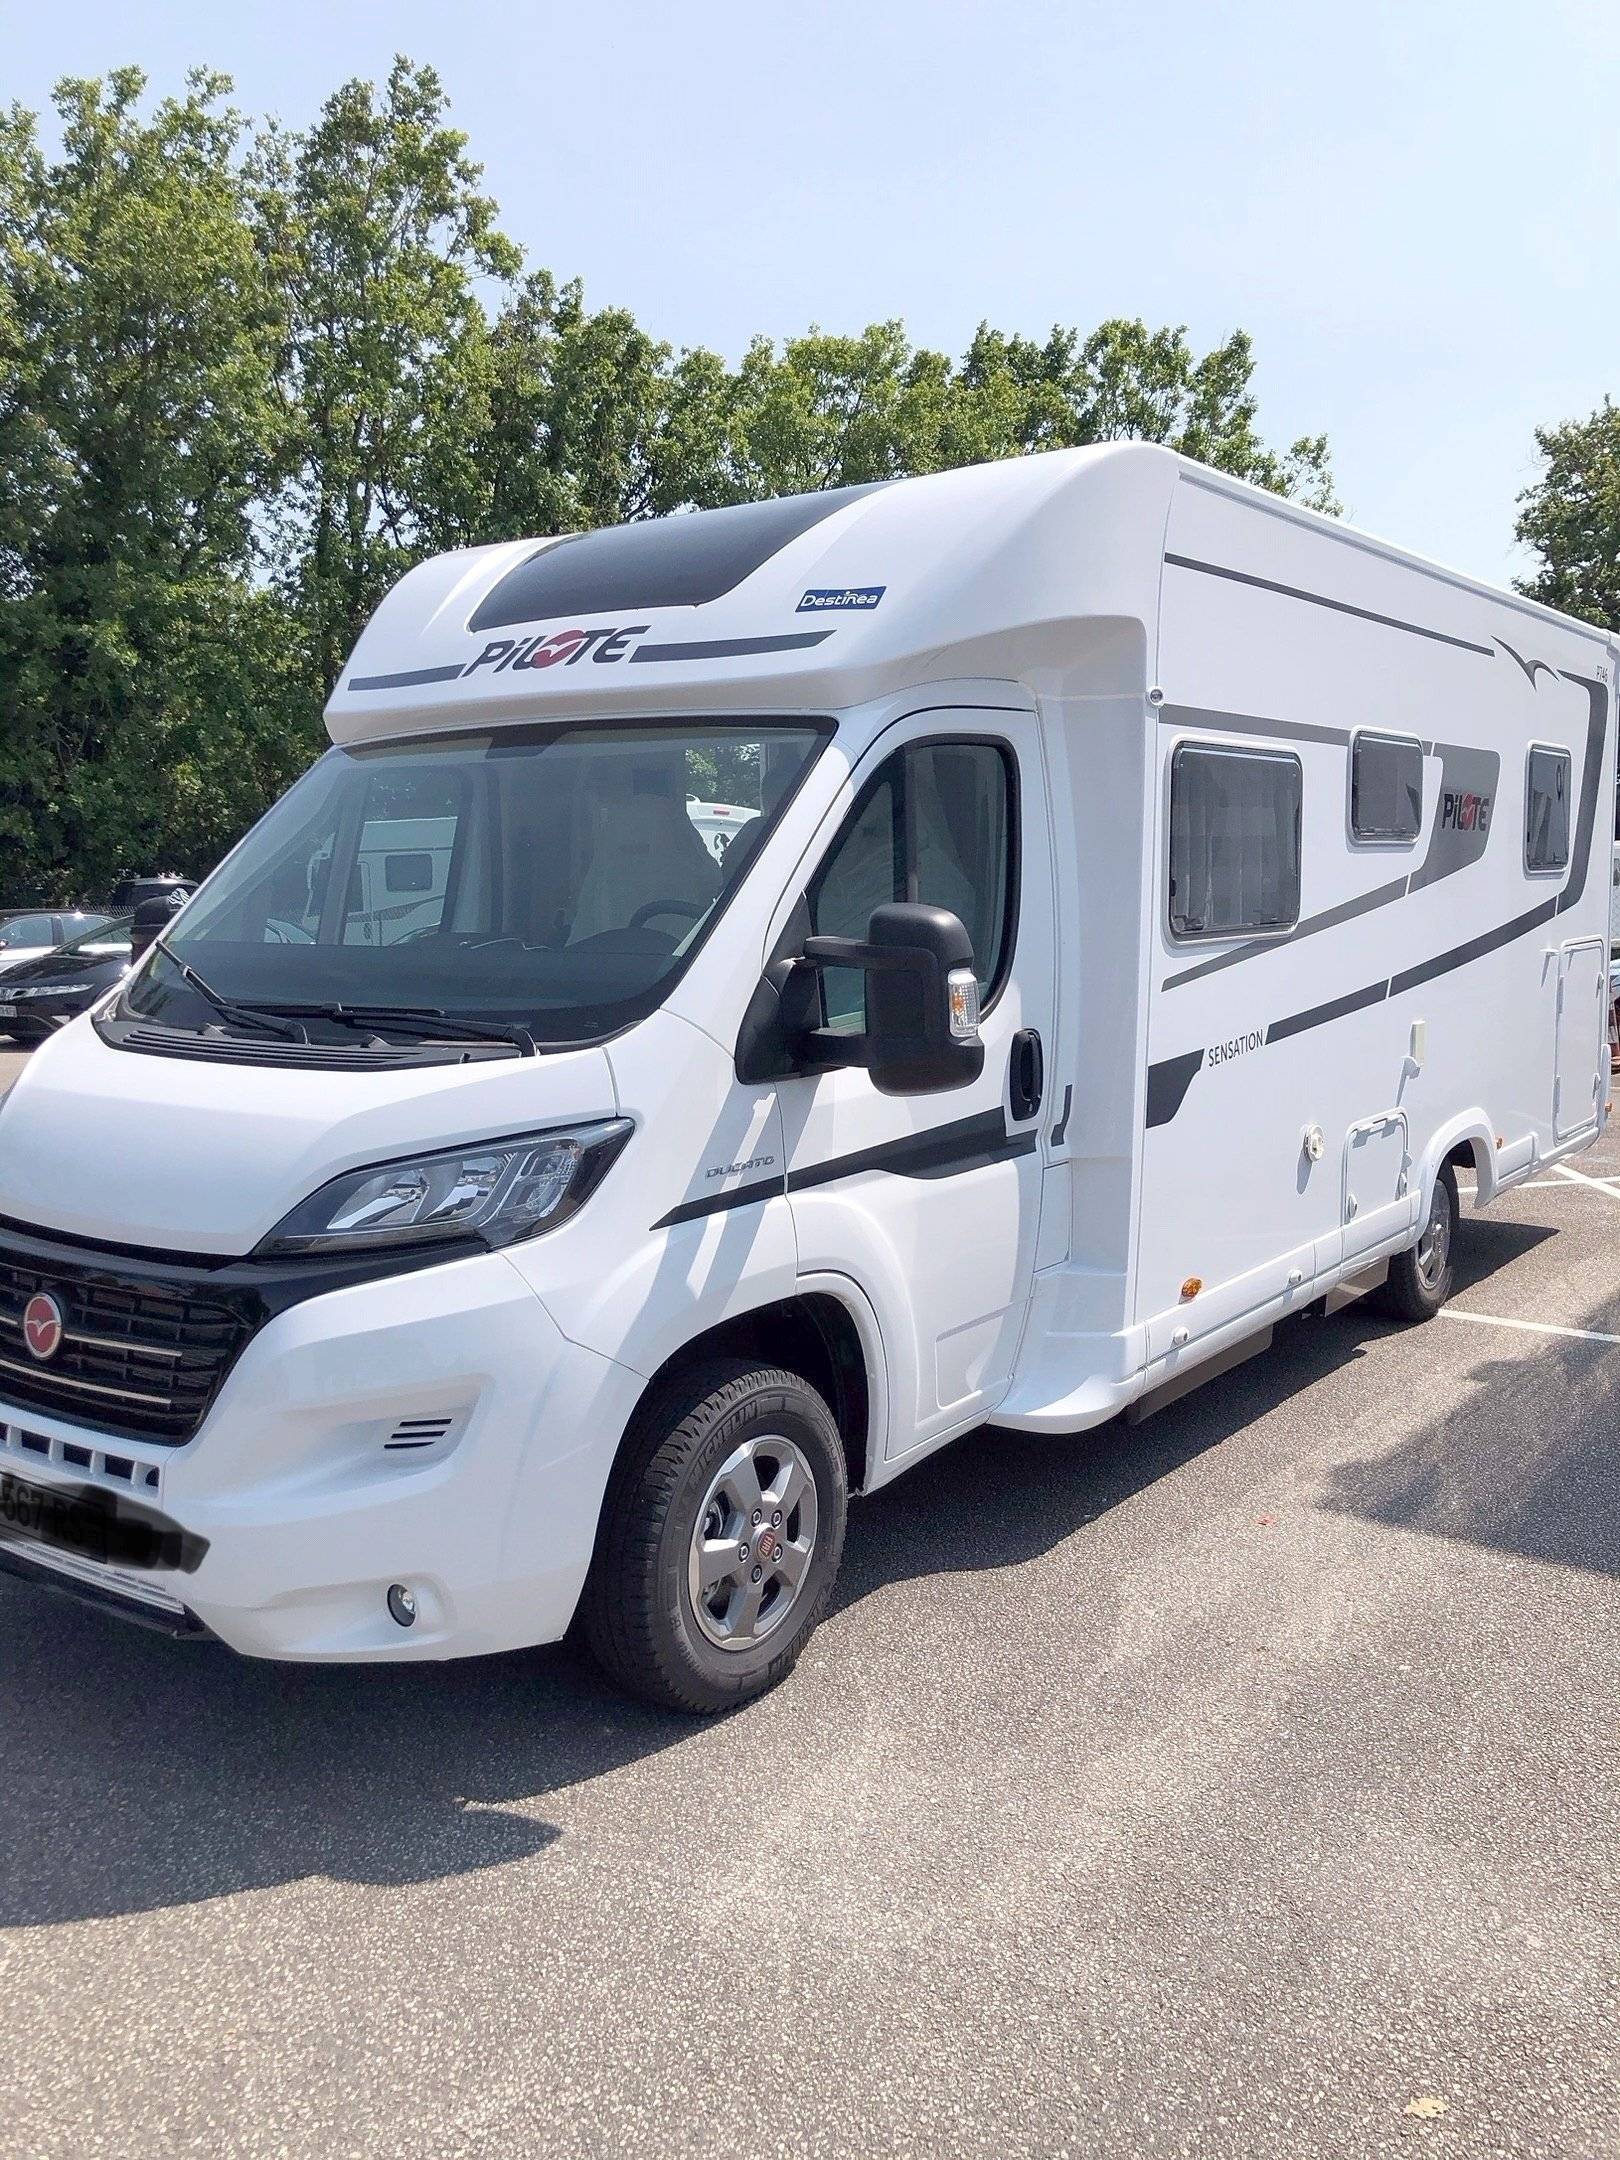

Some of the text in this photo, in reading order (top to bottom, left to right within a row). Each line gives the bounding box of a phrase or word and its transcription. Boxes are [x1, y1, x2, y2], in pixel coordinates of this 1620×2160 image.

[800, 591, 878, 607] Destinea
[1208, 1029, 1263, 1067] SENSATION
[706, 1156, 775, 1177] DUCATO
